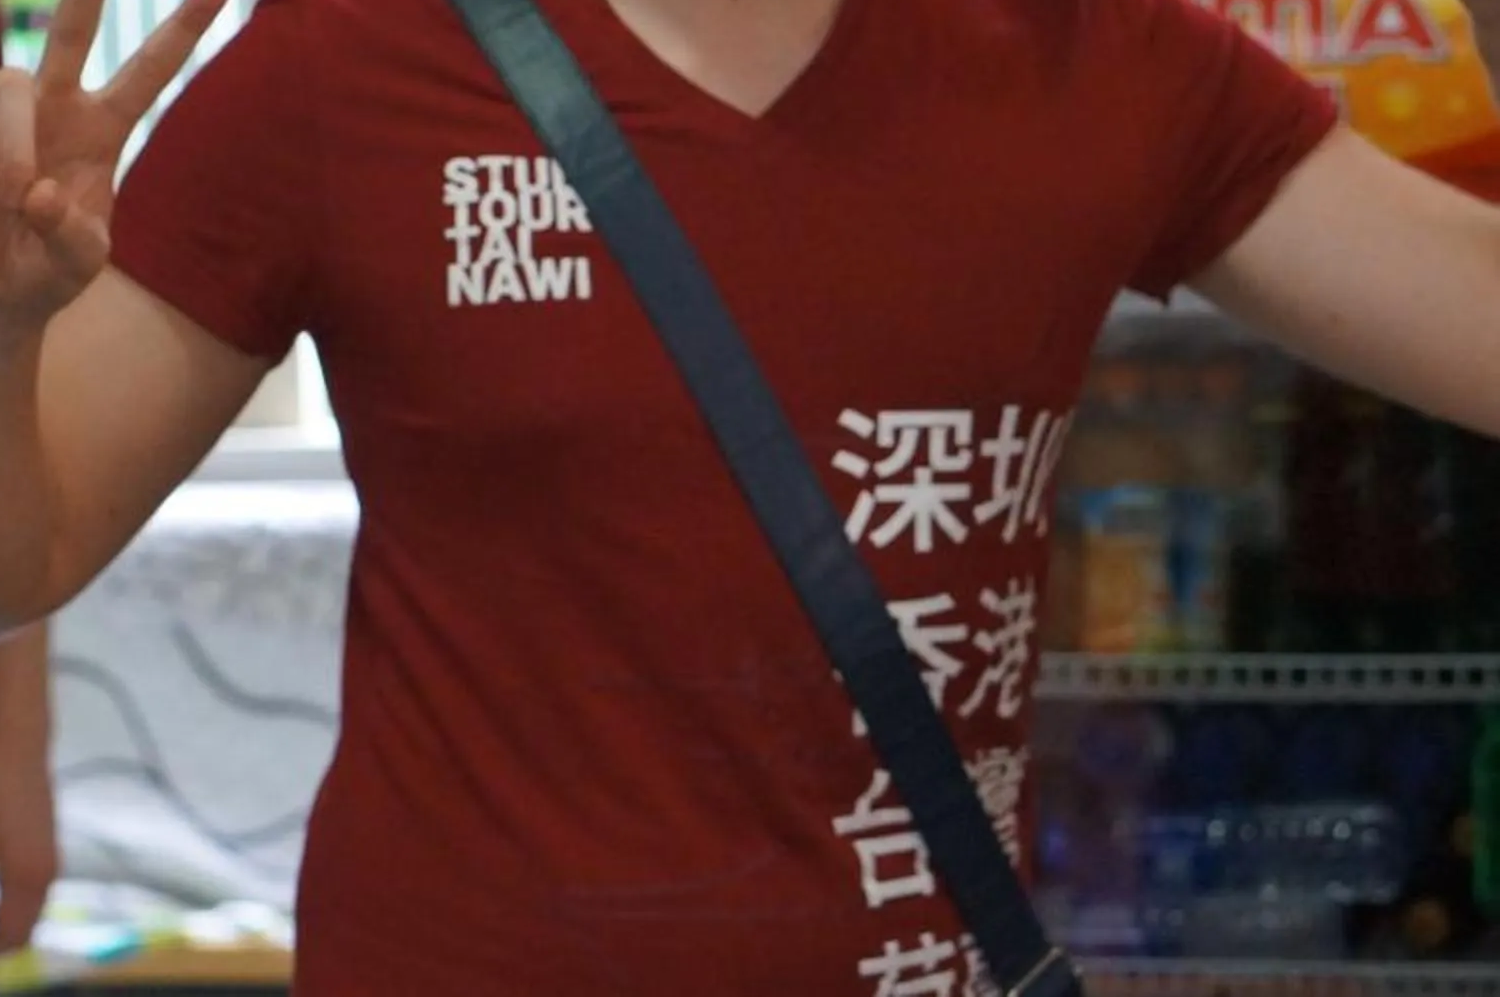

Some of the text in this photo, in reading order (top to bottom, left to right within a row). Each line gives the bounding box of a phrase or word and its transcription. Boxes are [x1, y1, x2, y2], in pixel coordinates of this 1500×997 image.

[443, 185, 593, 234] TOUR
[447, 256, 592, 307] NAWI
[831, 404, 1075, 554] 深圳
